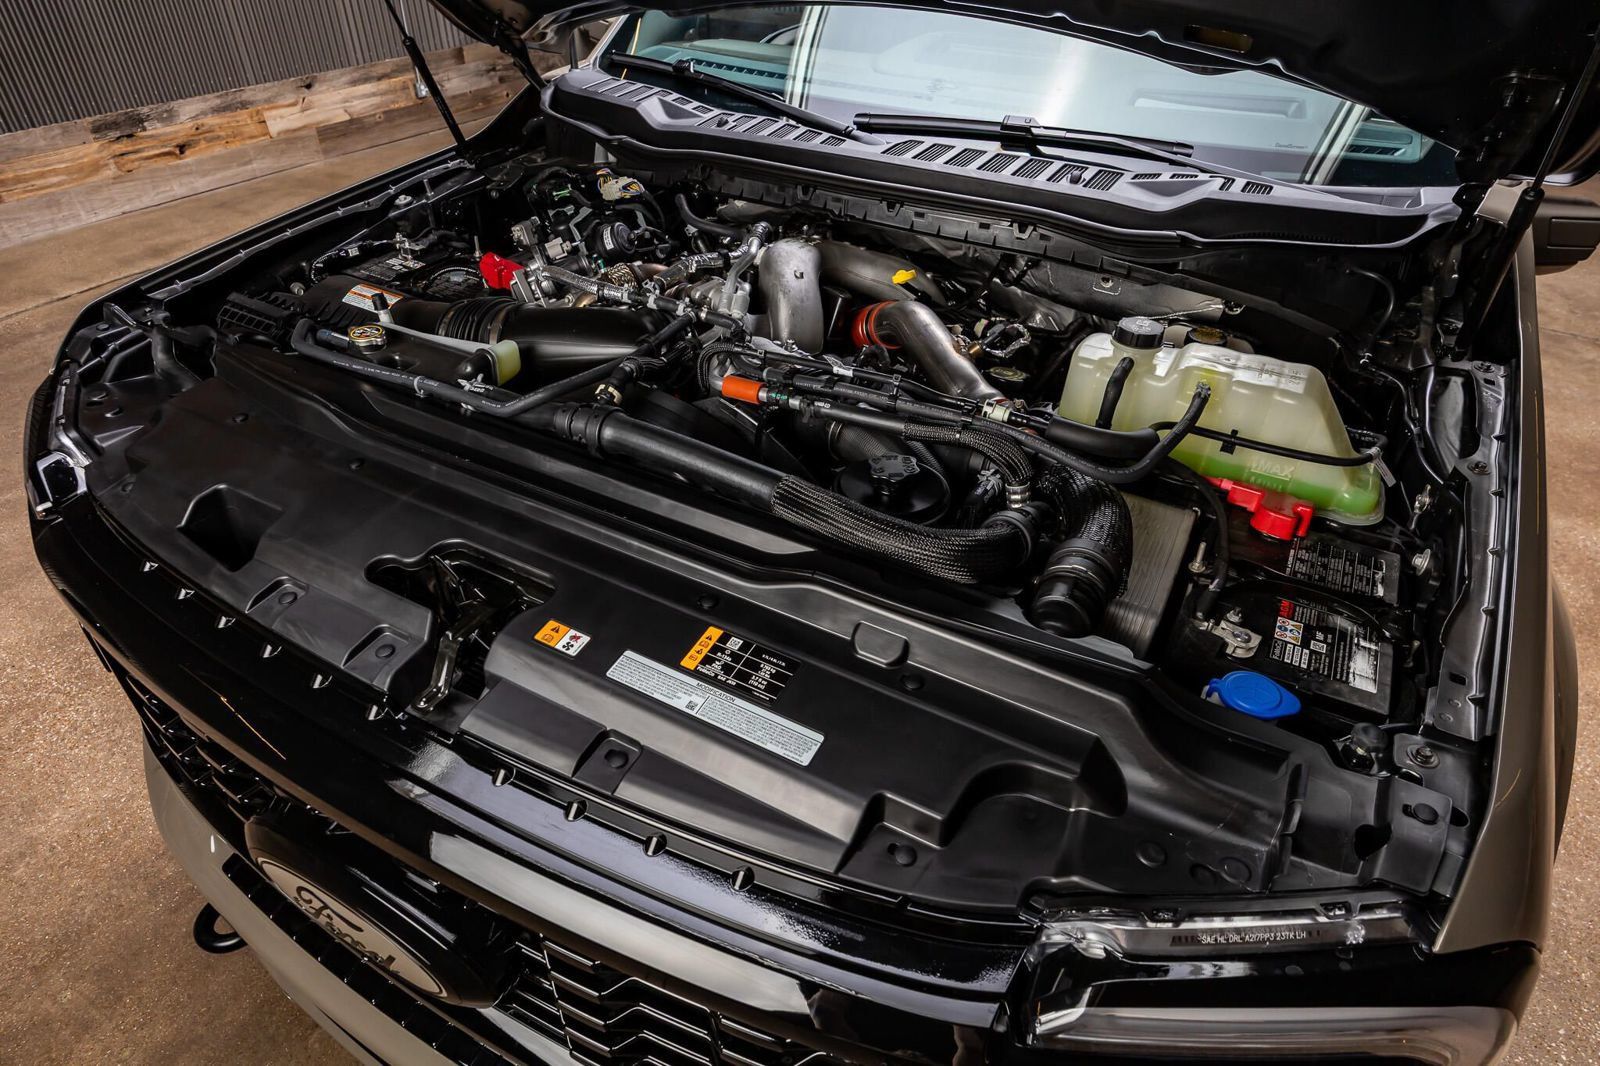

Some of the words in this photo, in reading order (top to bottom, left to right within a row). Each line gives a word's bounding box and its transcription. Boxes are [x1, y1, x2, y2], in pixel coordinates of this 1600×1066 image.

[1272, 640, 1283, 660] FoMoCo
[696, 682, 736, 703] MODIFICATION
[1201, 933, 1215, 945] SAE
[1217, 934, 1227, 944] HL
[1229, 933, 1243, 943] DRL
[1295, 930, 1306, 939] LH
